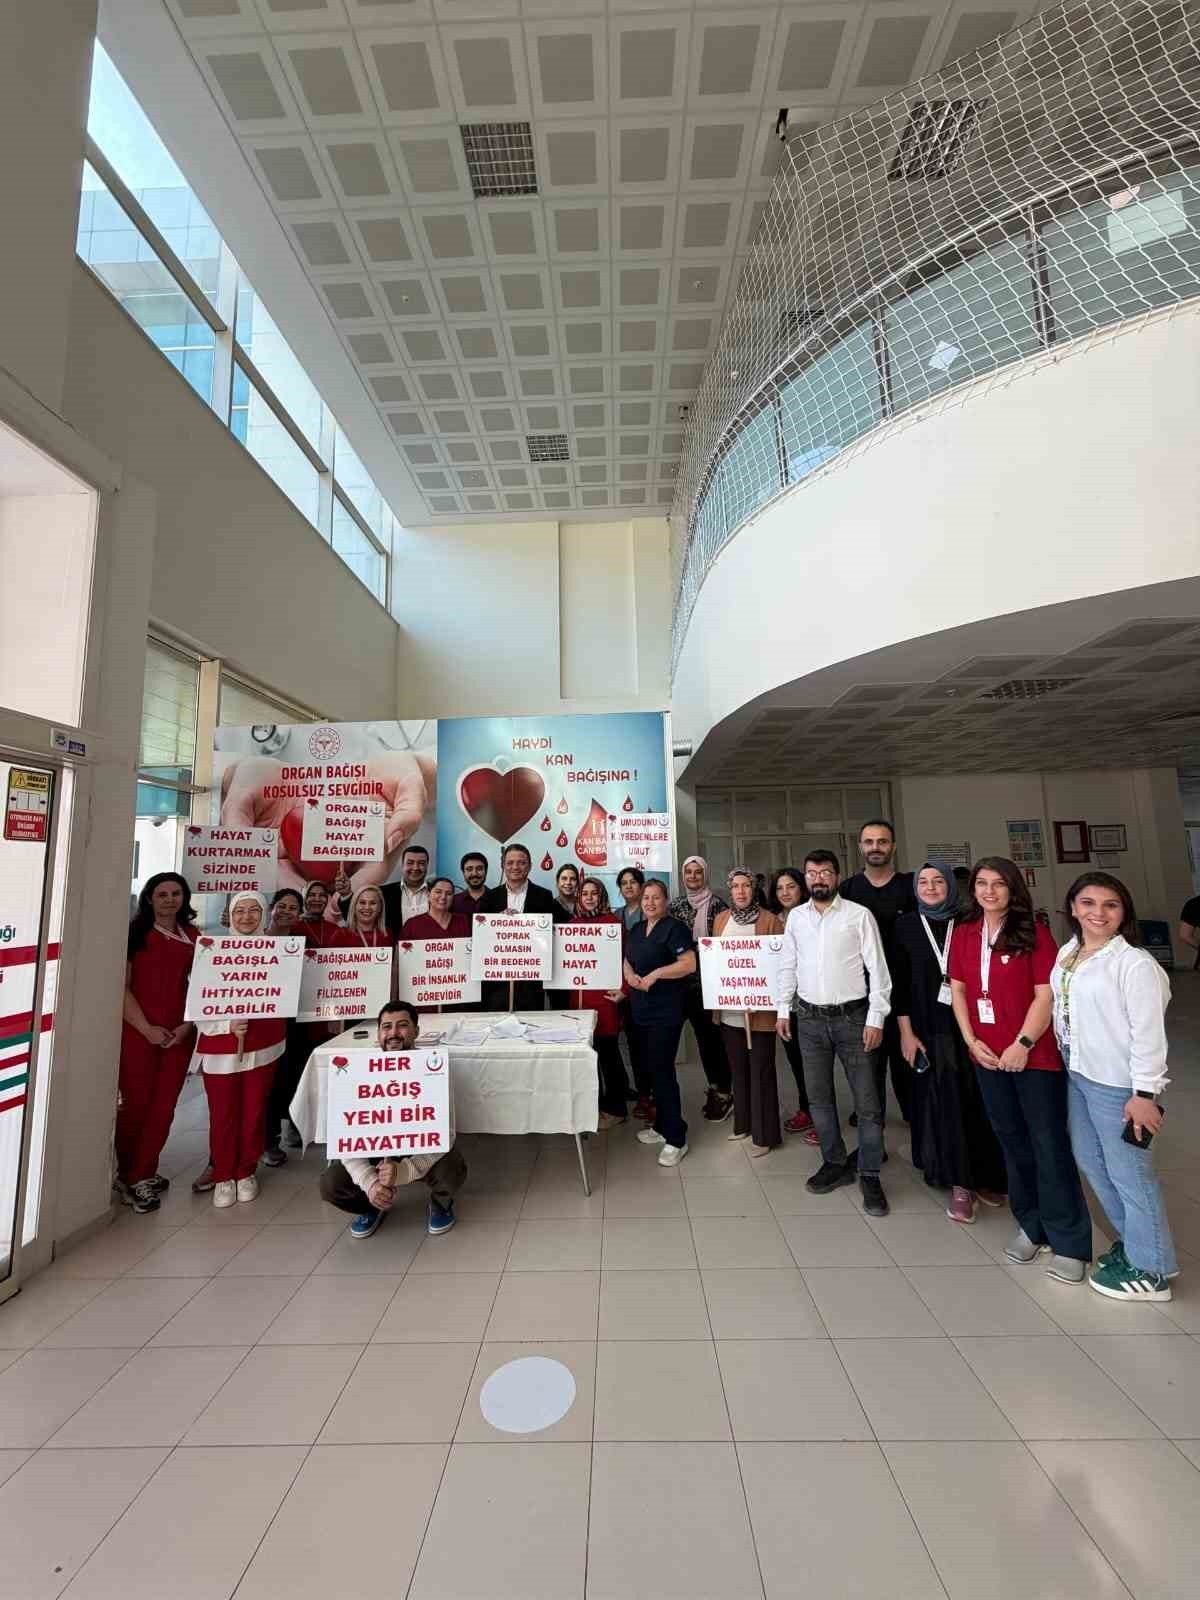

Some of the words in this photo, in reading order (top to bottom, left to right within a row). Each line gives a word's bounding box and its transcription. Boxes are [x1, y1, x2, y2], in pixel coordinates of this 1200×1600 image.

[512, 737, 552, 749] HAYDİ
[546, 754, 573, 766] KAN
[282, 766, 322, 780] ORGAN
[567, 768, 630, 784] BAĞIŞINA
[328, 781, 383, 797] SEVGİDİR
[325, 804, 368, 813] ORGAN
[325, 816, 366, 829] BAĞIŞI
[620, 818, 657, 826] UMUDUNU
[210, 830, 252, 841] HAYAT
[326, 832, 364, 841] HAYAT
[187, 847, 271, 858] KURTARMAK
[313, 845, 375, 857] BAĞIŞIDIR
[628, 847, 650, 856] UMUT
[202, 862, 256, 874] SİZİNDE
[197, 880, 259, 892] ELİNİZDE
[496, 932, 530, 940] TOPRAK
[558, 927, 602, 936] TOPRAK
[220, 937, 275, 949] BUGÜN
[425, 942, 454, 952] ORGAN
[494, 945, 532, 953] OLMASIN
[565, 943, 596, 952] OLMA
[720, 939, 762, 953] YAŞAMAK
[212, 954, 279, 967] BAĞIŞLA
[317, 952, 372, 965] BAĞIŞLANAN
[425, 957, 453, 969] BAĞIŞI
[484, 957, 498, 966] BİR
[501, 958, 541, 966] BEDENDE
[562, 960, 598, 969] HAYAT
[727, 956, 757, 969] GÜZEL
[221, 972, 267, 981] YARIN
[328, 970, 359, 981] ORGAN
[412, 974, 426, 986] BİR
[428, 973, 466, 985] İNSANLIK
[485, 970, 503, 978] CAN
[505, 970, 540, 979] BULSUN
[573, 976, 588, 985] OL
[720, 976, 768, 990] YAŞATMAK
[202, 986, 281, 998] İHTİYACIN
[316, 986, 367, 999] FİLİZLENEN
[417, 989, 462, 1002] GÖREVİDİR
[718, 995, 741, 1006] DAHA
[743, 993, 774, 1006] GÜZEL
[202, 1002, 276, 1015] OLABİLİR
[333, 1004, 366, 1016] CANDIR
[368, 1057, 411, 1072] HER
[358, 1080, 421, 1099] BAĞIŞ
[343, 1106, 393, 1126] YENİ
[400, 1104, 436, 1122] BİR
[338, 1132, 441, 1153] HAYATTIR
